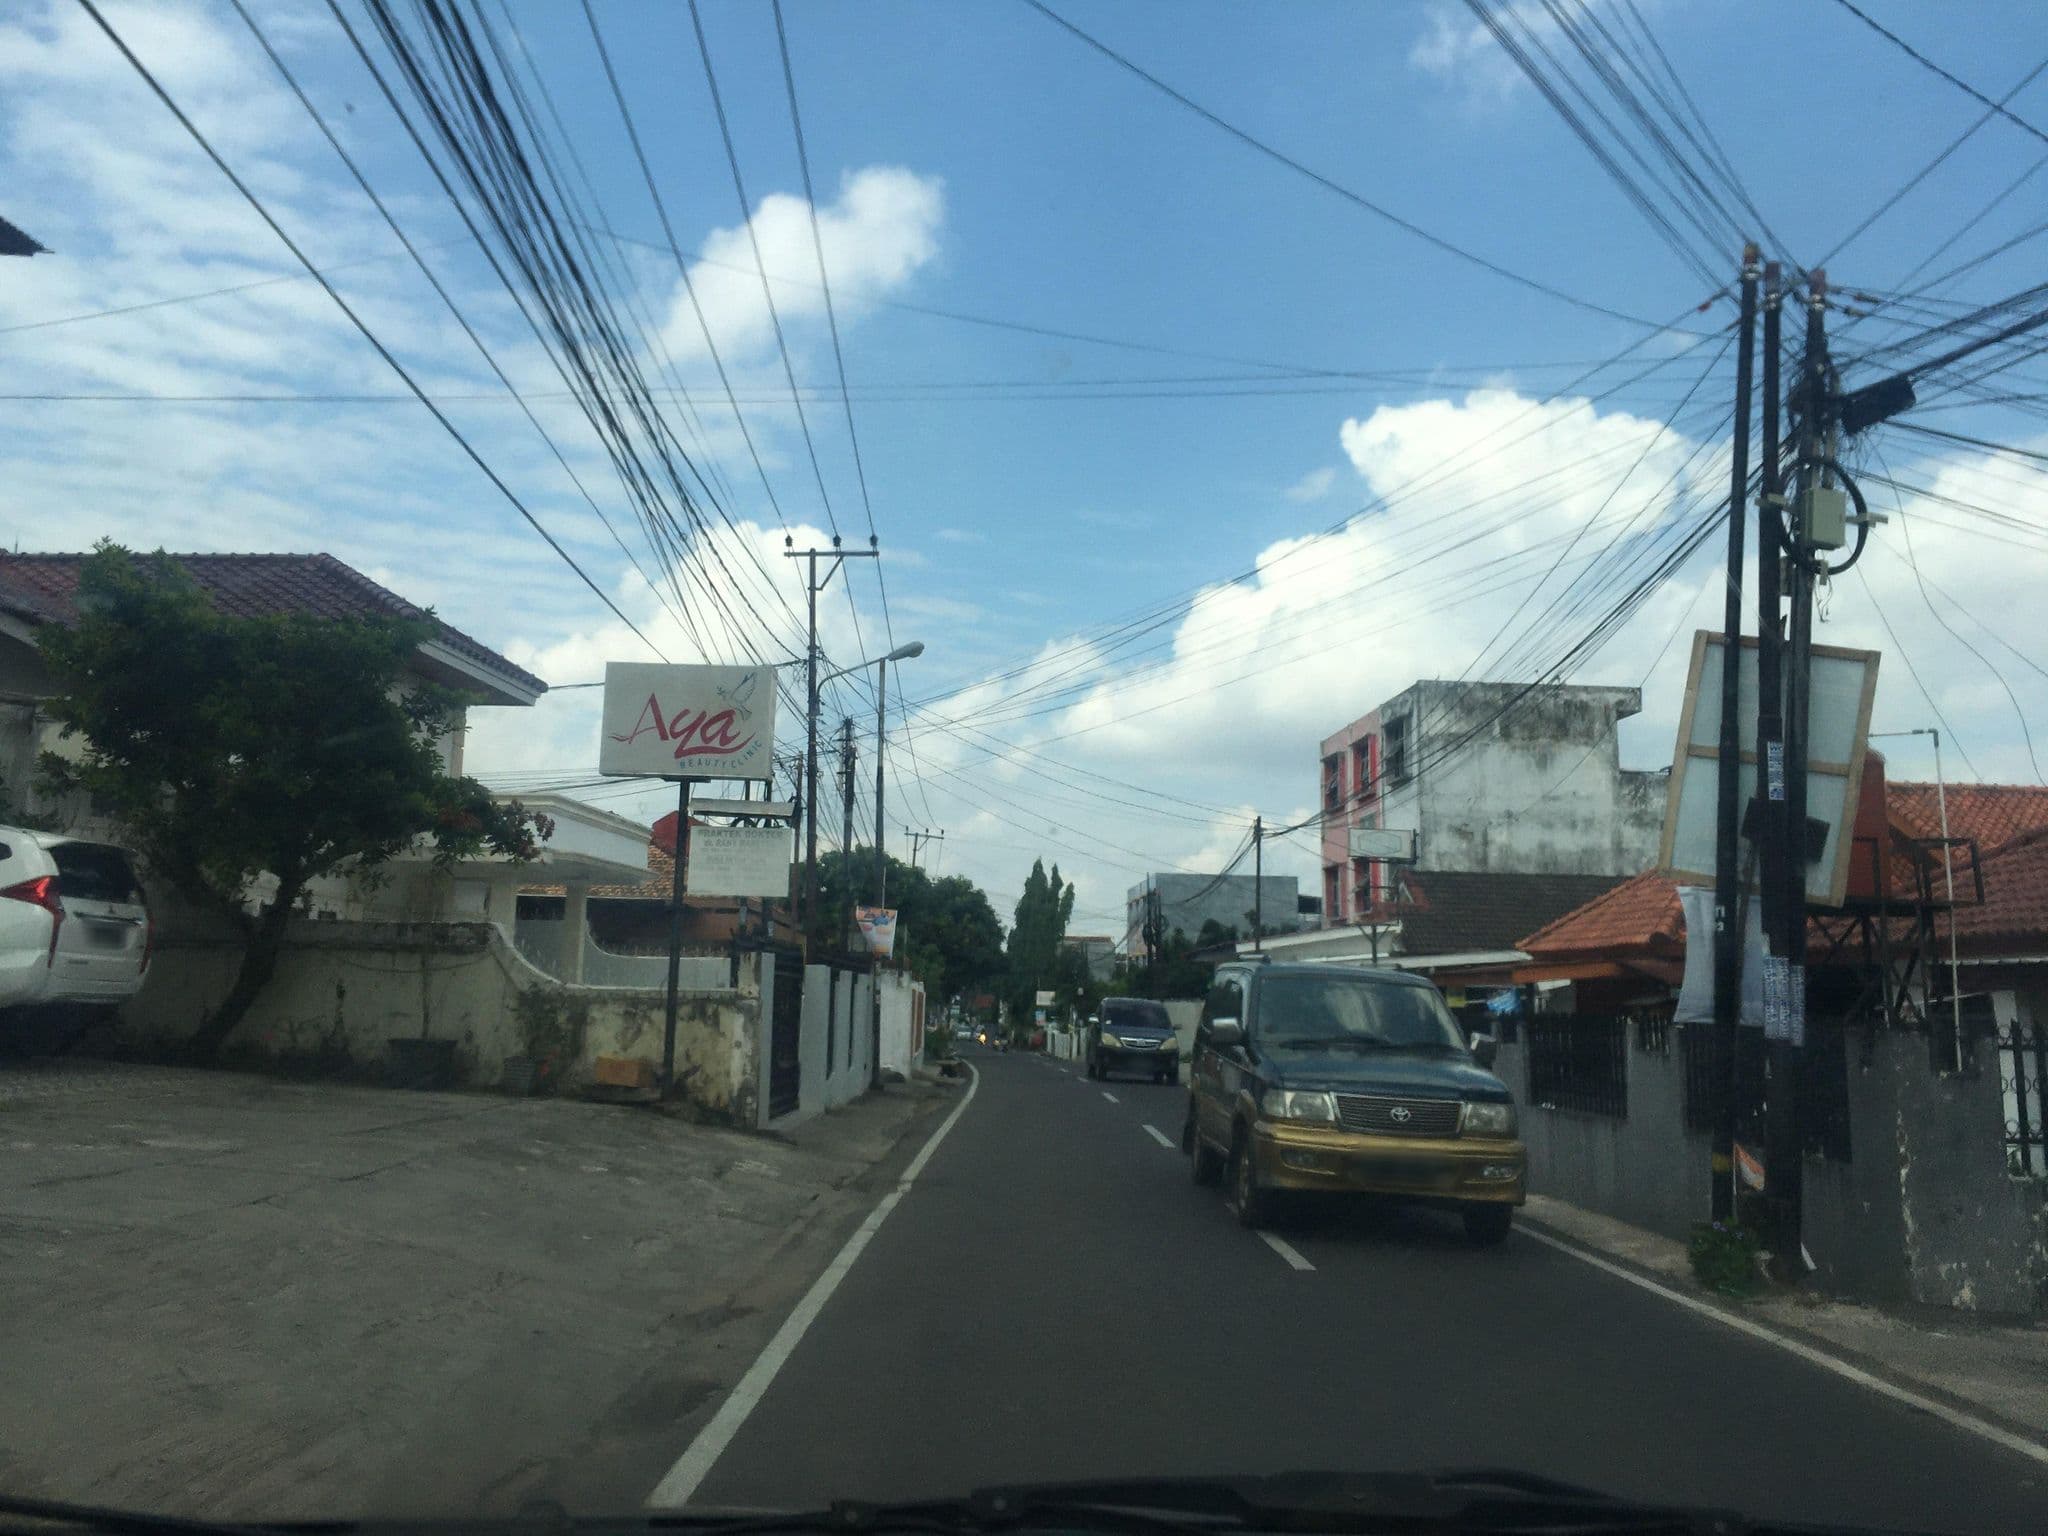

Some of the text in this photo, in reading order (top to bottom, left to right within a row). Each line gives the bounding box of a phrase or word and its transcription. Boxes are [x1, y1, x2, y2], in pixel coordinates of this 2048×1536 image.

[609, 692, 756, 759] Aya
[679, 740, 763, 769] BEAUTY CLINIC
